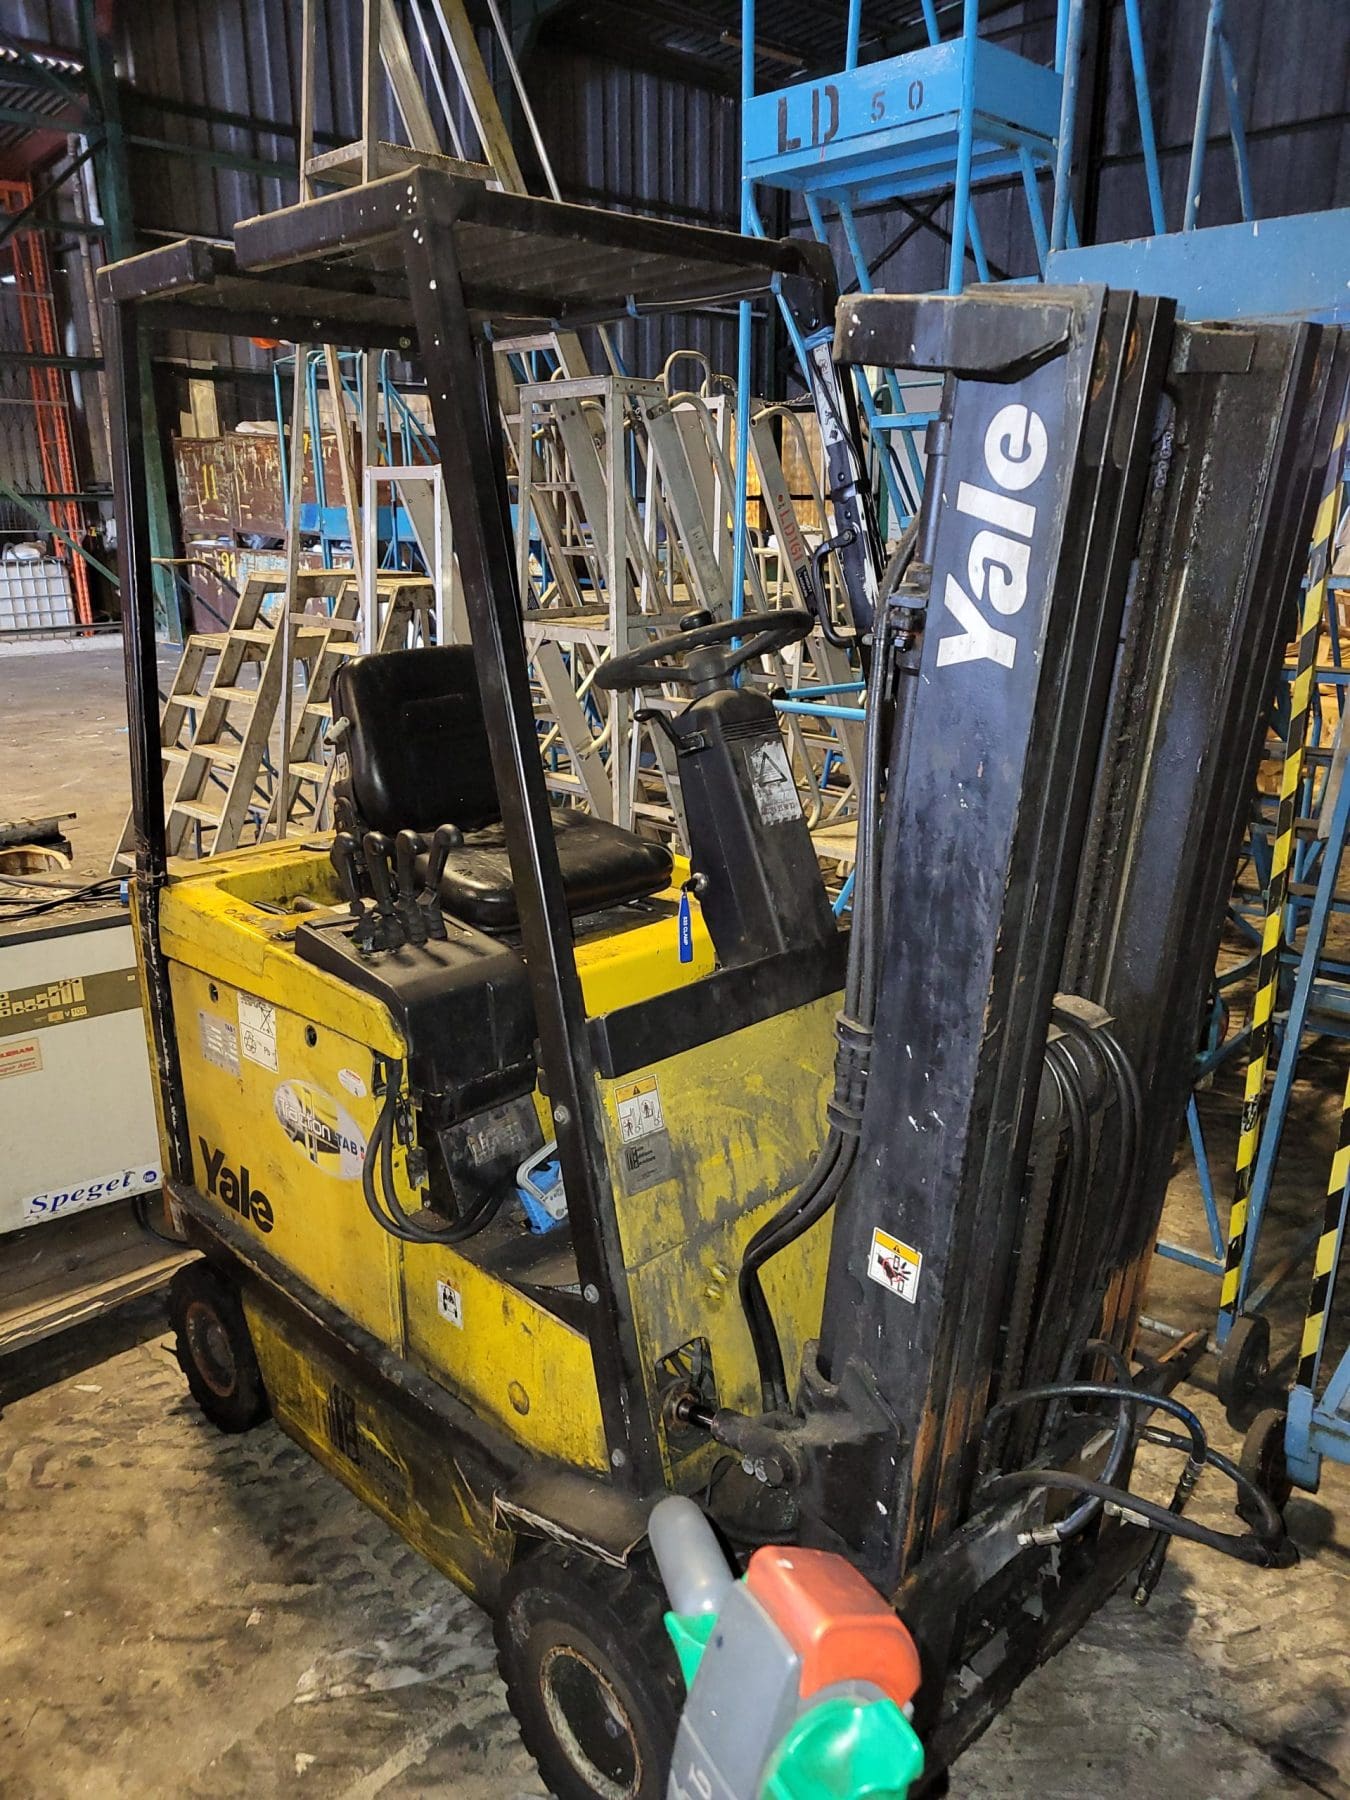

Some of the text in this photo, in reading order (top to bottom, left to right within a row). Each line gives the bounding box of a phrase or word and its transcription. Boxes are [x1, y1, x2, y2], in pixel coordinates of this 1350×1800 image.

[777, 84, 840, 153] LD
[936, 403, 1049, 670] Yale
[198, 1135, 275, 1234] Yale
[335, 1132, 358, 1156] TAB
